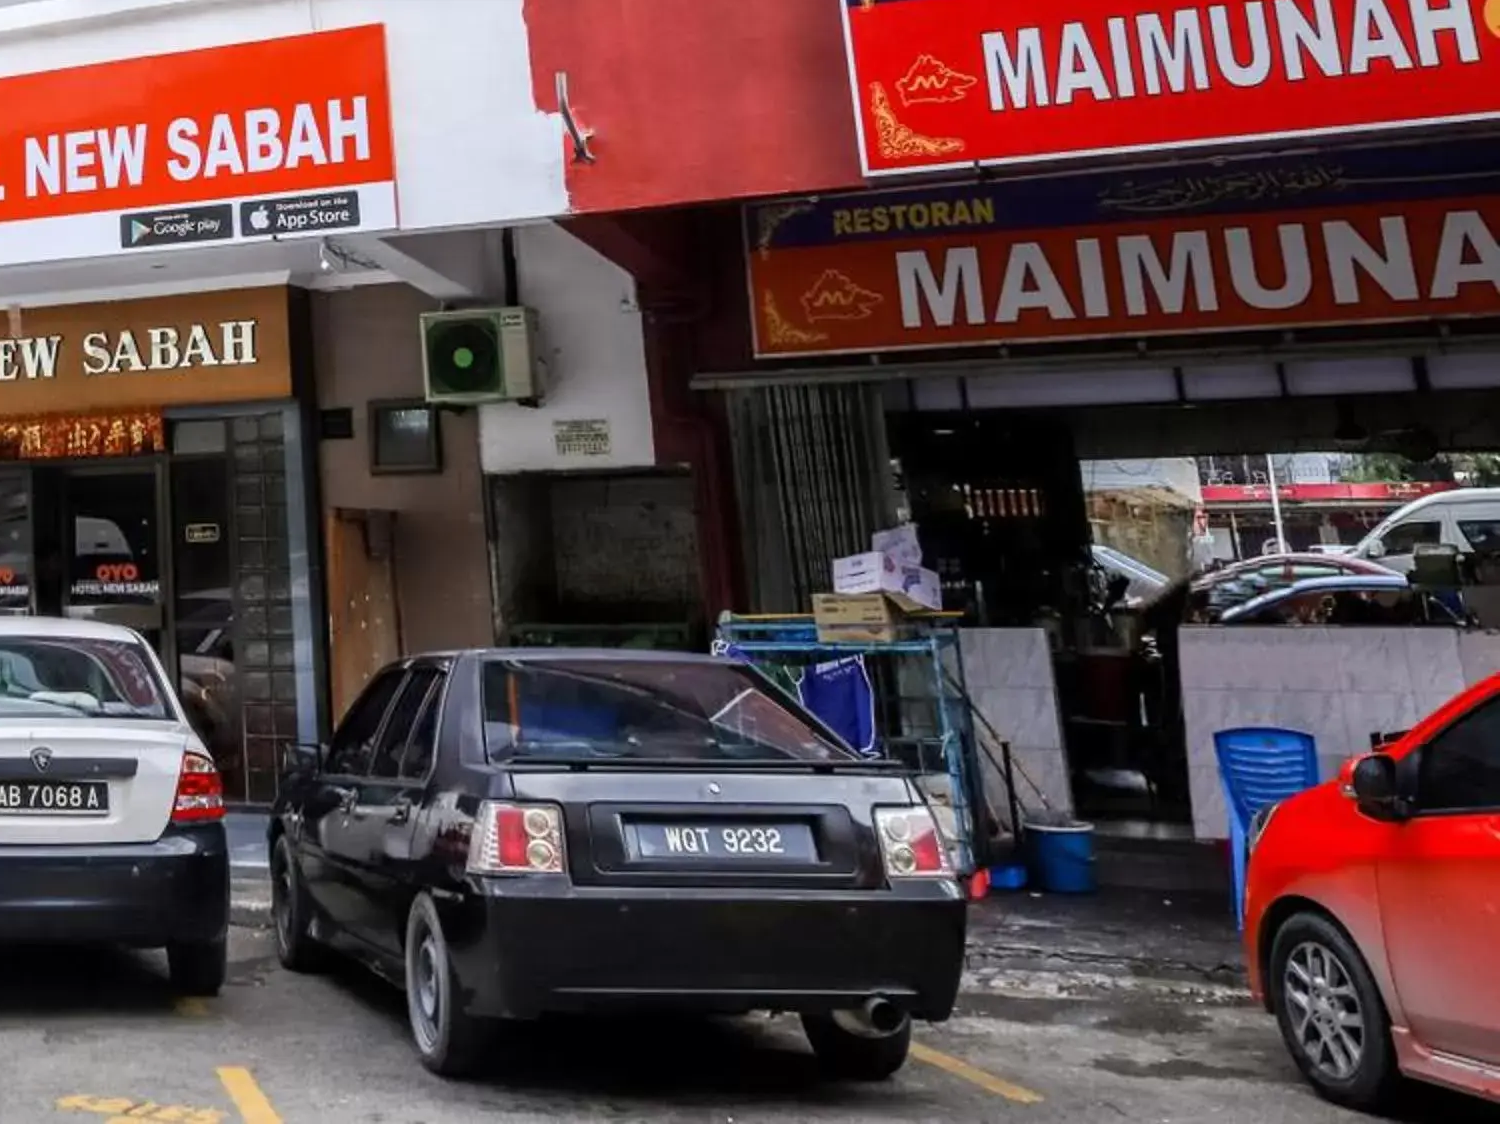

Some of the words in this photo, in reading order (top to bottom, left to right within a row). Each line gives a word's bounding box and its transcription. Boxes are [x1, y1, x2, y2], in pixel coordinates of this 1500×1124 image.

[24, 122, 148, 197] NEW
[166, 95, 371, 182] SABAH
[153, 219, 197, 238] Google
[197, 217, 222, 235] play
[276, 213, 308, 230] App
[309, 208, 350, 224] Store
[832, 197, 996, 236] RESTORAN
[82, 319, 258, 376] SABAH
[27, 785, 82, 808] 7068
[87, 785, 99, 808] A
[664, 827, 710, 853] WQT
[722, 827, 785, 853] 9232
